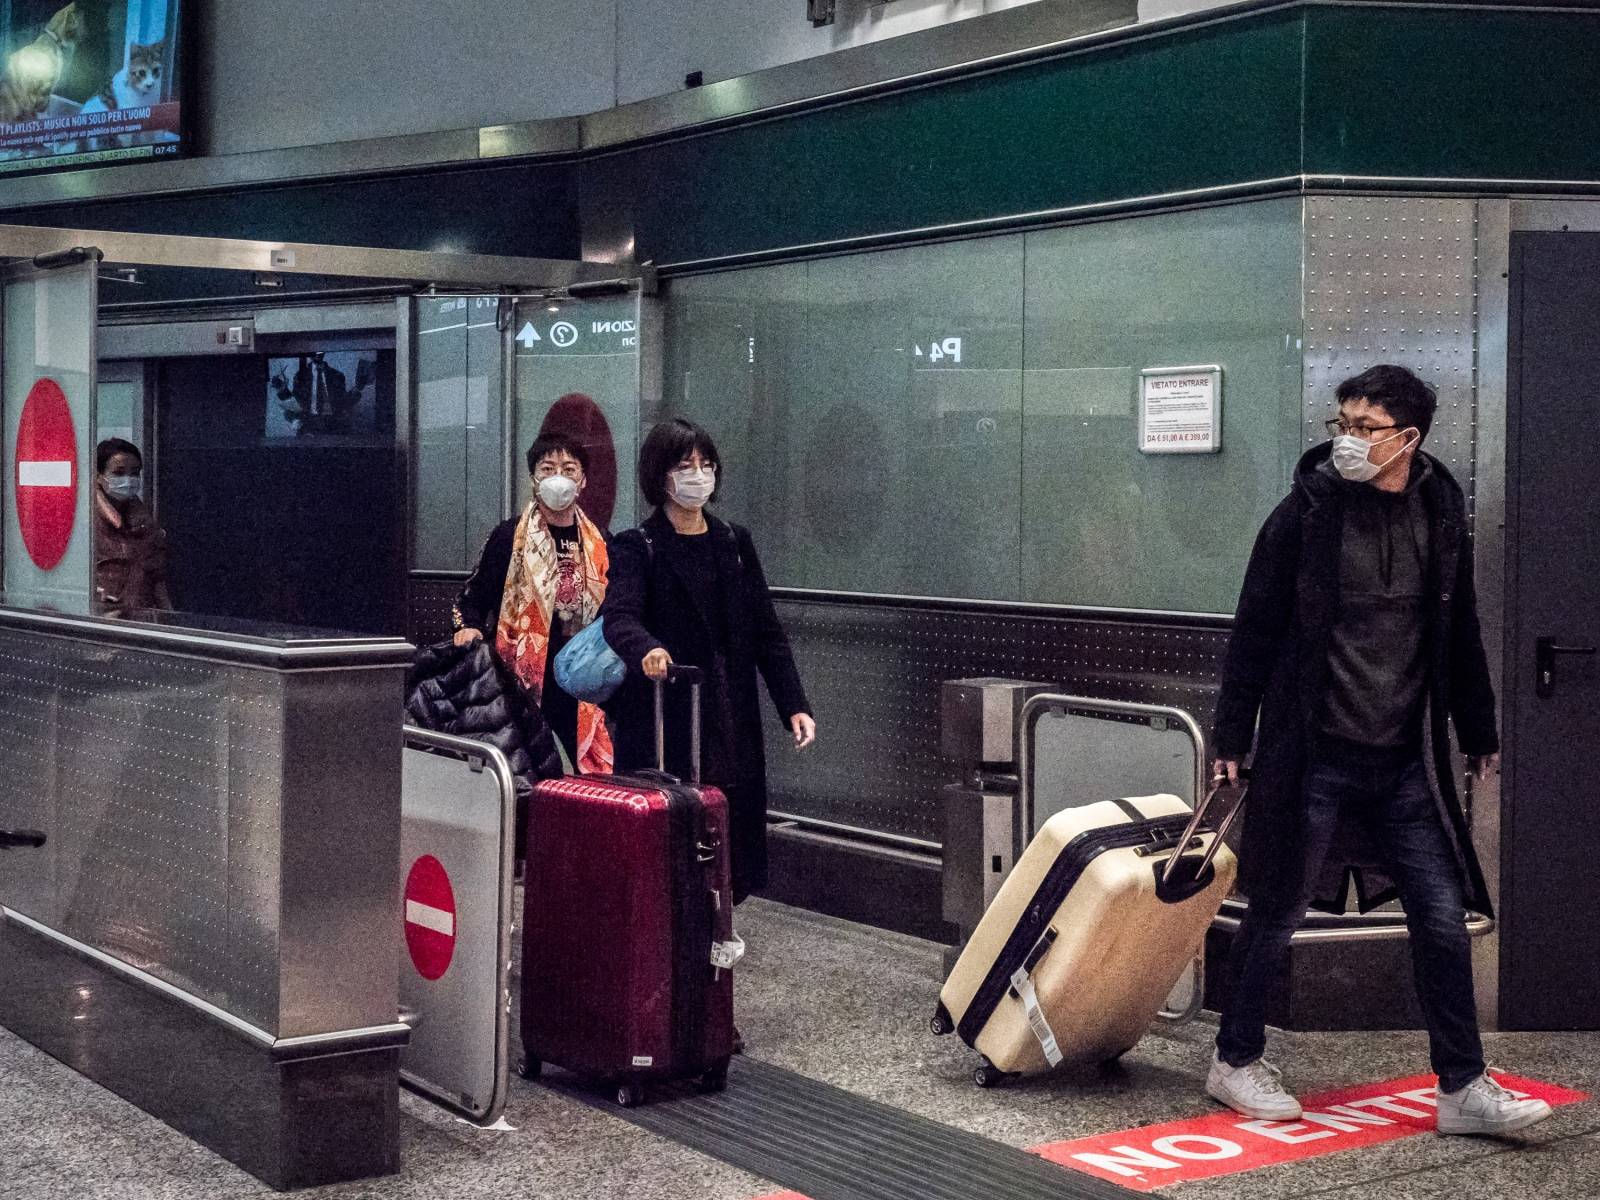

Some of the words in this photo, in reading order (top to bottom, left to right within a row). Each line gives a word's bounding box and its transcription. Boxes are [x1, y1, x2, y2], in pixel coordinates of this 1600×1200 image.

[6, 120, 43, 135] PLAYLISTS:
[44, 117, 70, 130] MUSICA
[71, 114, 87, 127] NON
[89, 111, 107, 125] SOLO
[108, 110, 122, 123] PER
[123, 106, 151, 121] L'UOMO
[1151, 380, 1178, 389] VIETATO
[1179, 379, 1208, 388] ENTRARE
[1147, 434, 1156, 442] DA
[1071, 1135, 1243, 1177] NO
